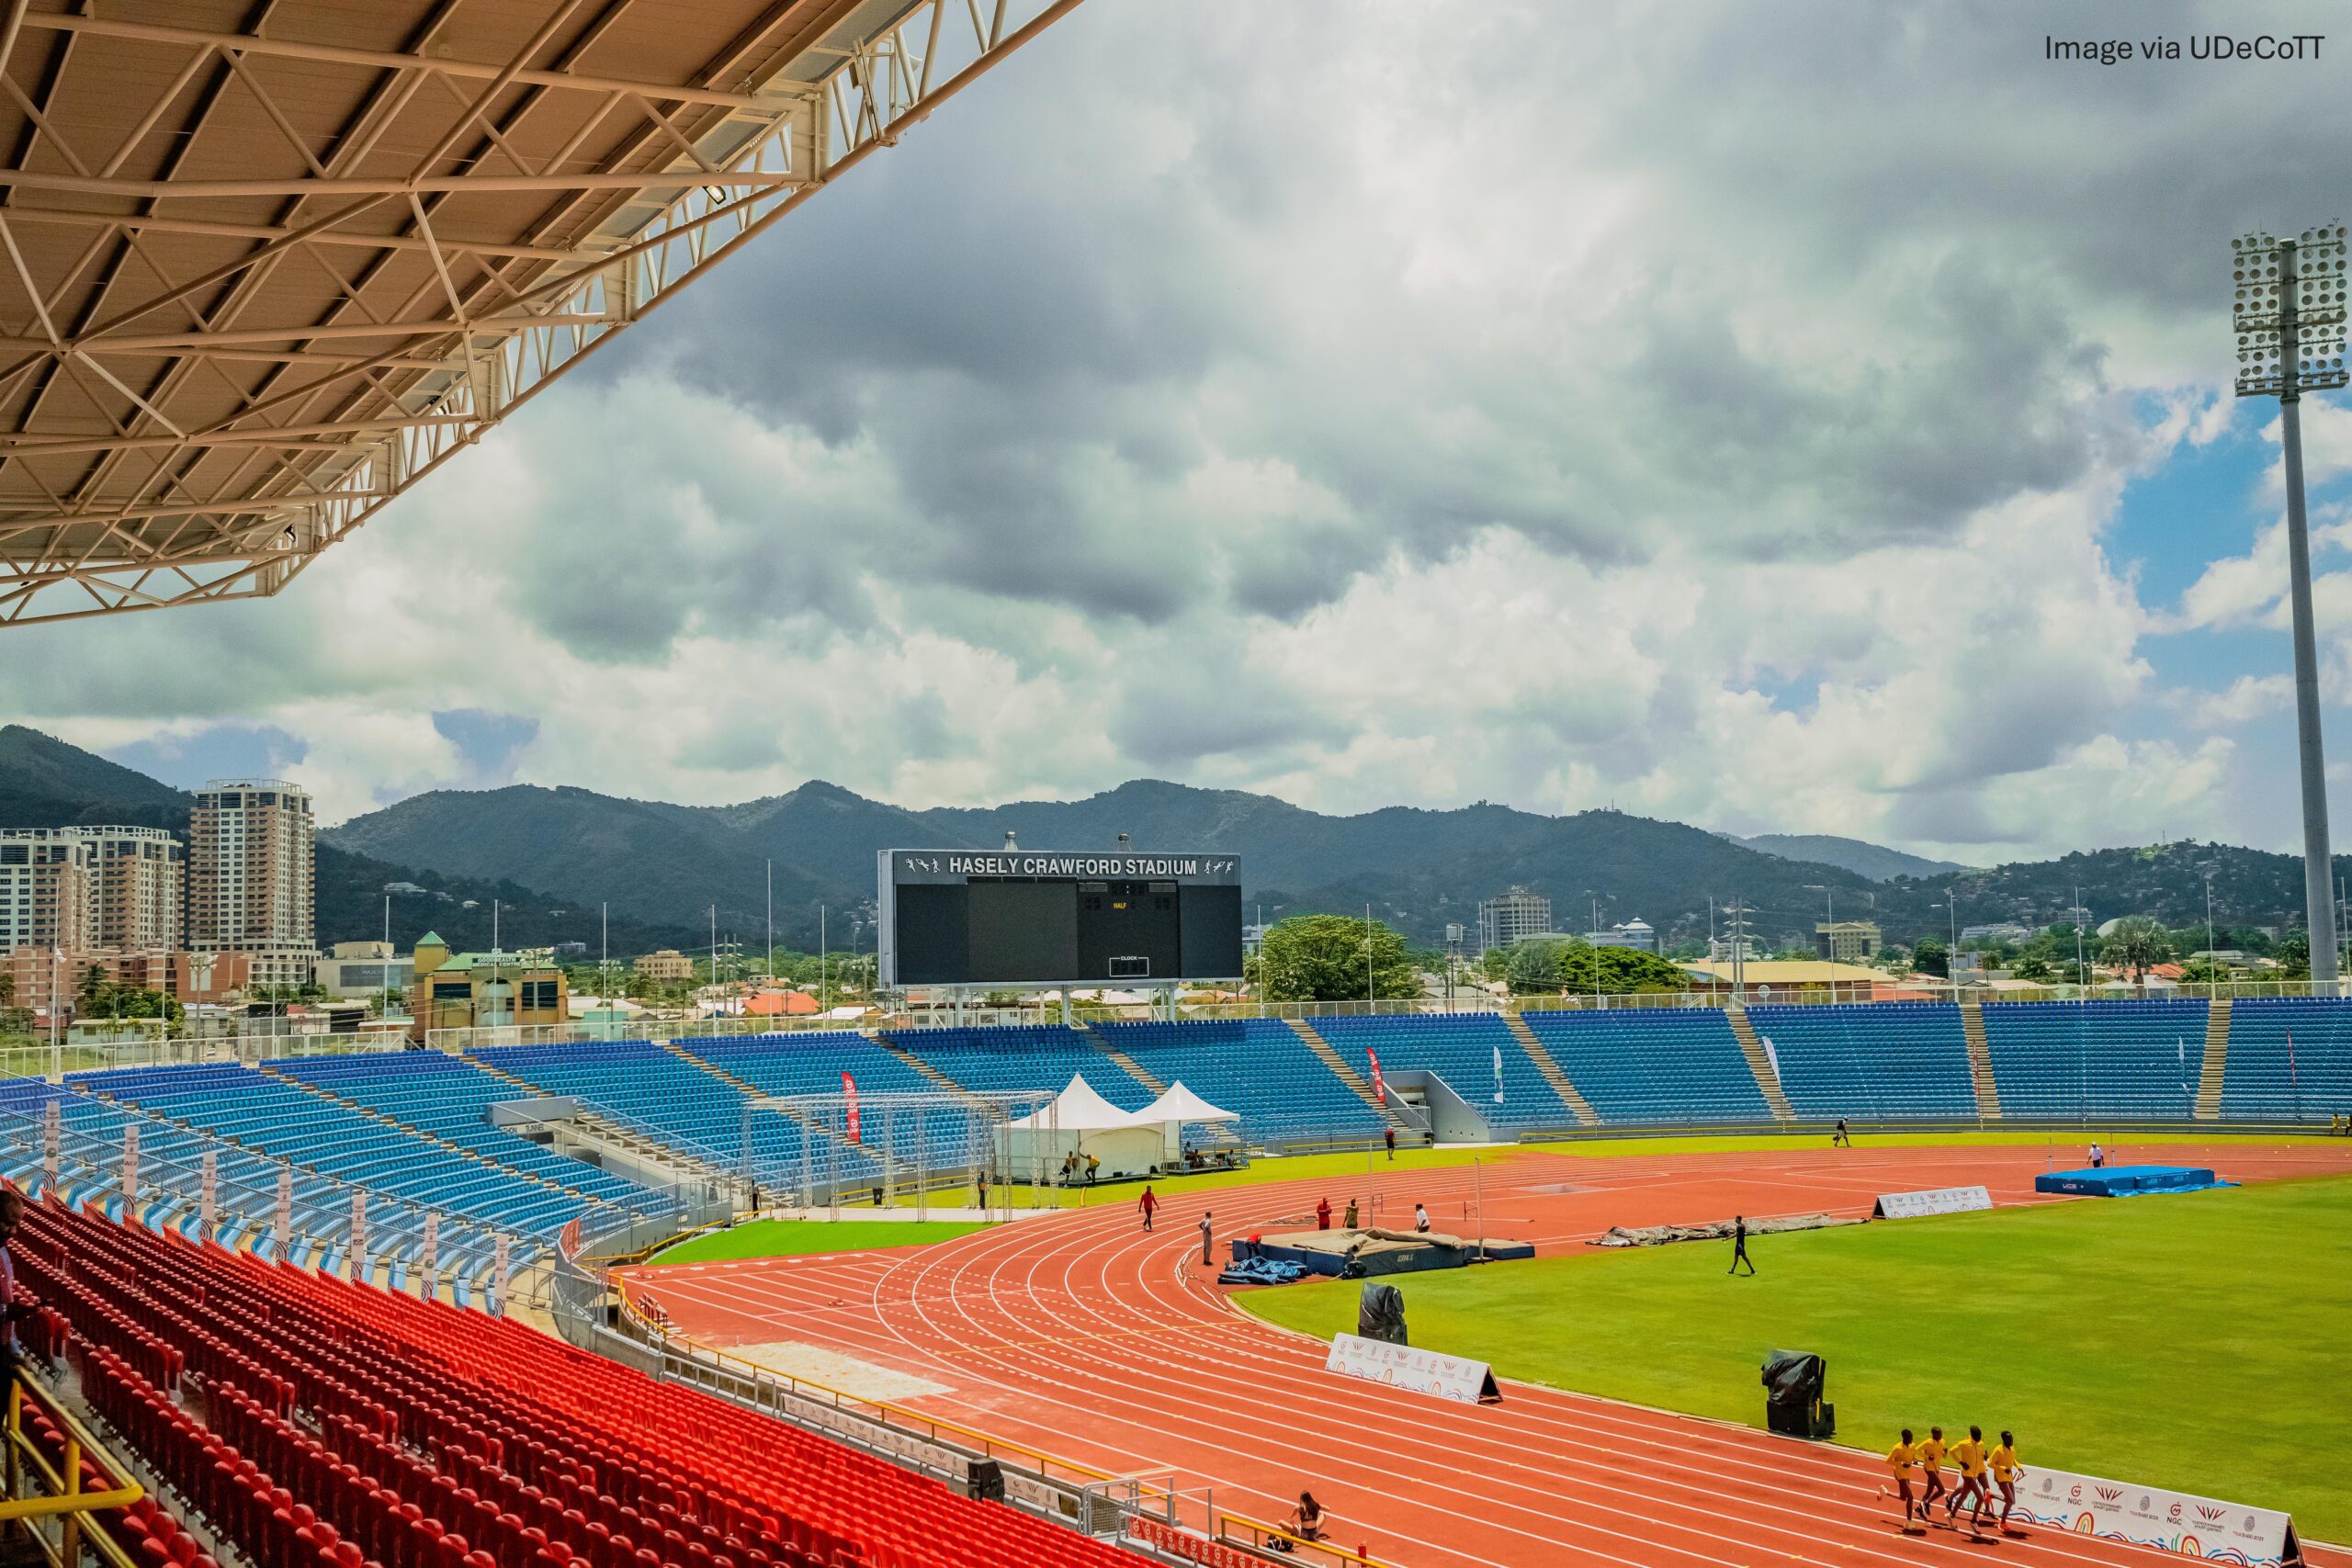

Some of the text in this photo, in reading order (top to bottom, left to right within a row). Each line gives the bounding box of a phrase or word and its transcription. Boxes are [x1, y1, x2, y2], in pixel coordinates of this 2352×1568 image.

[949, 857, 1196, 875] HASELY CRAWFORD STADIUM
[2067, 1497, 2082, 1506] NGC
[2166, 1516, 2183, 1526] NGC
